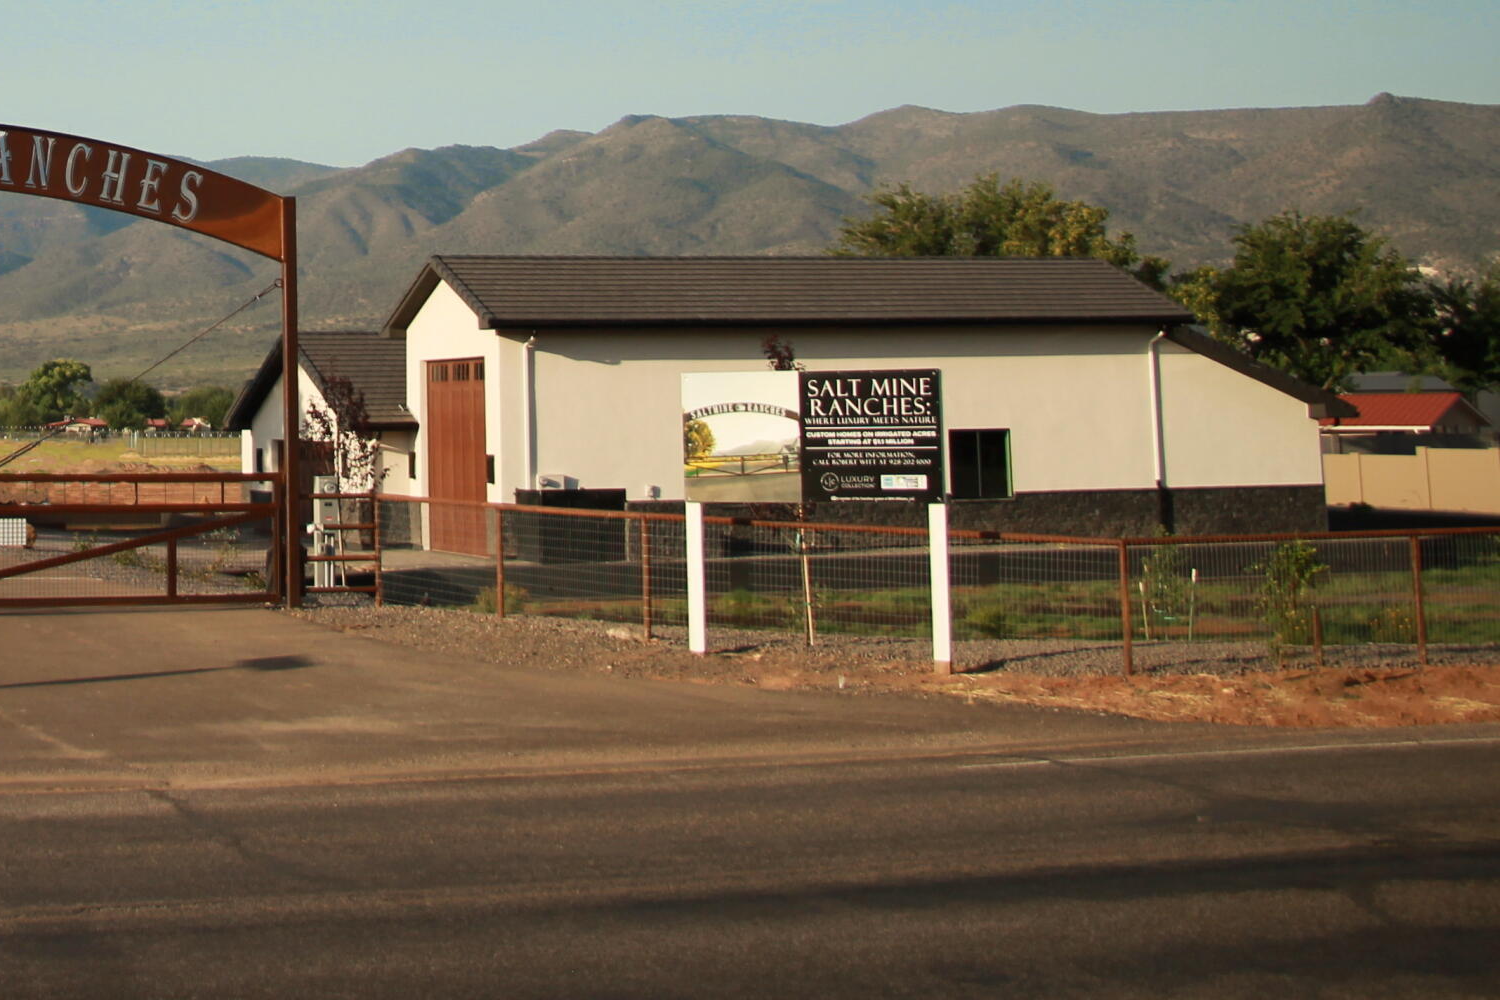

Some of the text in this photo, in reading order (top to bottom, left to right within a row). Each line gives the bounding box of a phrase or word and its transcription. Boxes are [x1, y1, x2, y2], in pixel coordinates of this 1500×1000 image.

[807, 377, 932, 397] SALT MINE
[810, 397, 931, 416] RANCHES:
[804, 417, 835, 425] WHERE
[872, 416, 900, 424] MEETS
[902, 416, 937, 424] NATURE
[874, 430, 912, 438] IRRIGATED
[840, 475, 875, 483] LUXURY
